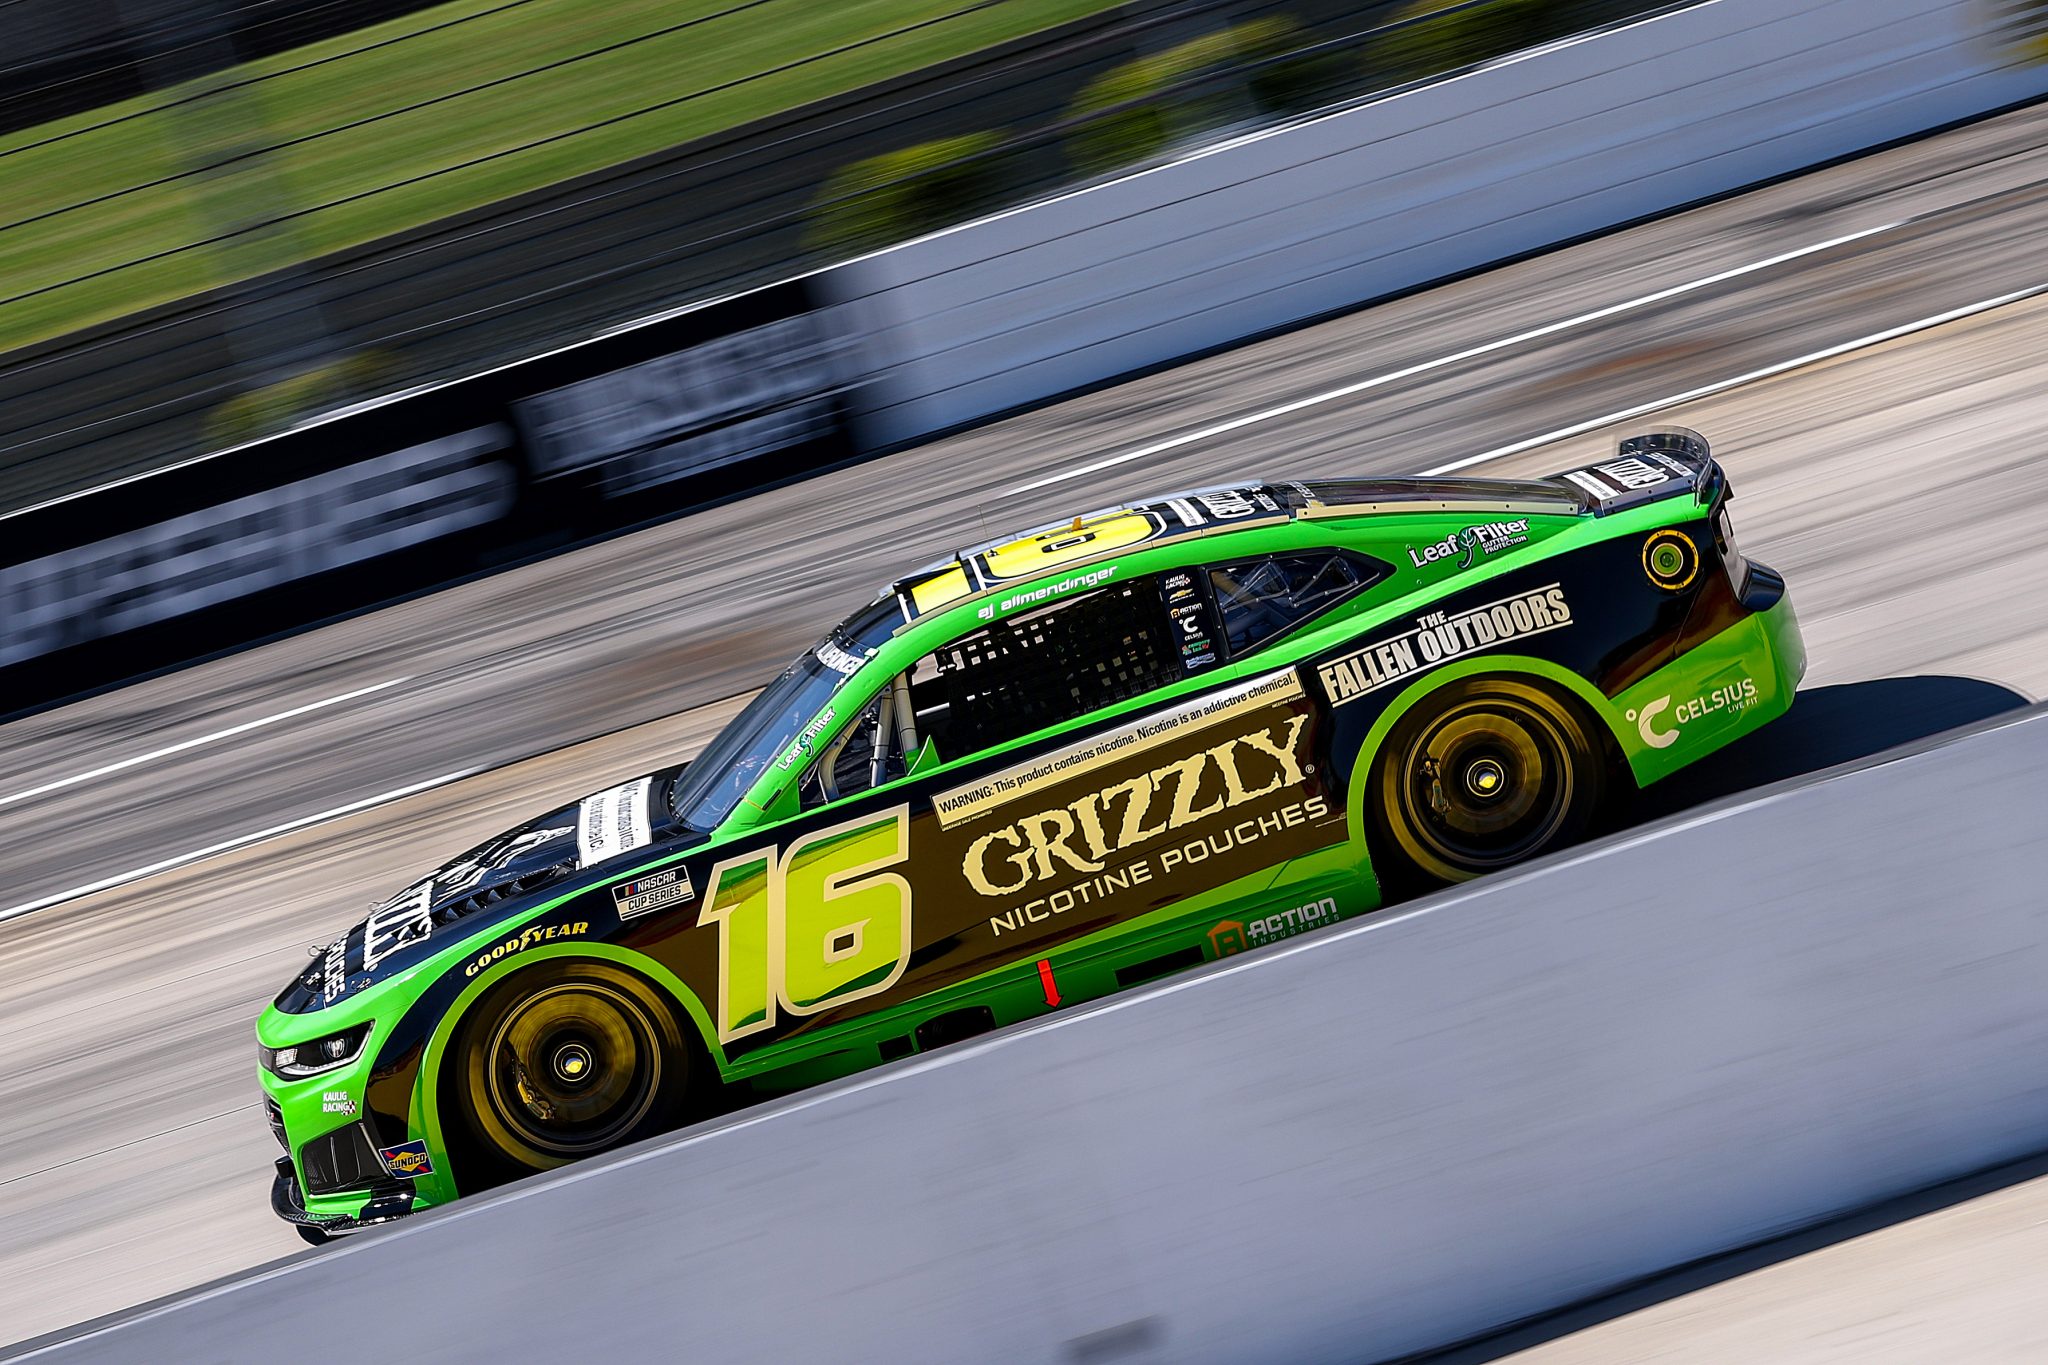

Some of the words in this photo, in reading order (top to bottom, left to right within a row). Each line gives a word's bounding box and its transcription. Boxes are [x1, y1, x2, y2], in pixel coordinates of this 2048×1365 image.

[1408, 534, 1459, 568] Leaf
[1474, 518, 1529, 543] Filter
[1482, 535, 1510, 548] GUTTER
[1484, 535, 1527, 555] PROTECTION
[1001, 565, 1118, 611] allmendinger
[1416, 610, 1448, 630] THE
[1318, 639, 1418, 702] FALLEN
[1417, 588, 1571, 663] OUTDOORS
[1675, 678, 1758, 724] CELSIUS
[1727, 701, 1745, 714] LIVE
[1745, 696, 1759, 709] FIT
[777, 742, 805, 771] Leaf
[808, 707, 836, 738] Filter
[939, 785, 995, 814] WARNING:
[993, 777, 1016, 793] This
[1017, 762, 1053, 788] product
[1054, 746, 1095, 771] contains
[1096, 734, 1138, 756] nicotine.
[1136, 719, 1178, 740] Nicotine
[1178, 713, 1189, 725] is
[1191, 707, 1203, 720] an
[1203, 692, 1247, 716] addictive
[1248, 673, 1296, 698] chemical.
[962, 713, 1309, 896] GRIZZLY
[637, 871, 677, 893] NASCAR
[989, 861, 1153, 937] NICOTINE
[1160, 795, 1329, 873] POUCHES
[628, 896, 647, 911] CUP
[648, 885, 682, 905] SERIES
[1248, 896, 1338, 939] ACTION
[697, 802, 913, 1045] 16
[1253, 913, 1340, 947] INDUSTRIES
[465, 921, 589, 977] GOODYEAR
[322, 1091, 348, 1101] KAULIG
[322, 1102, 350, 1113] RACING
[389, 1153, 427, 1169] SUNOCO
